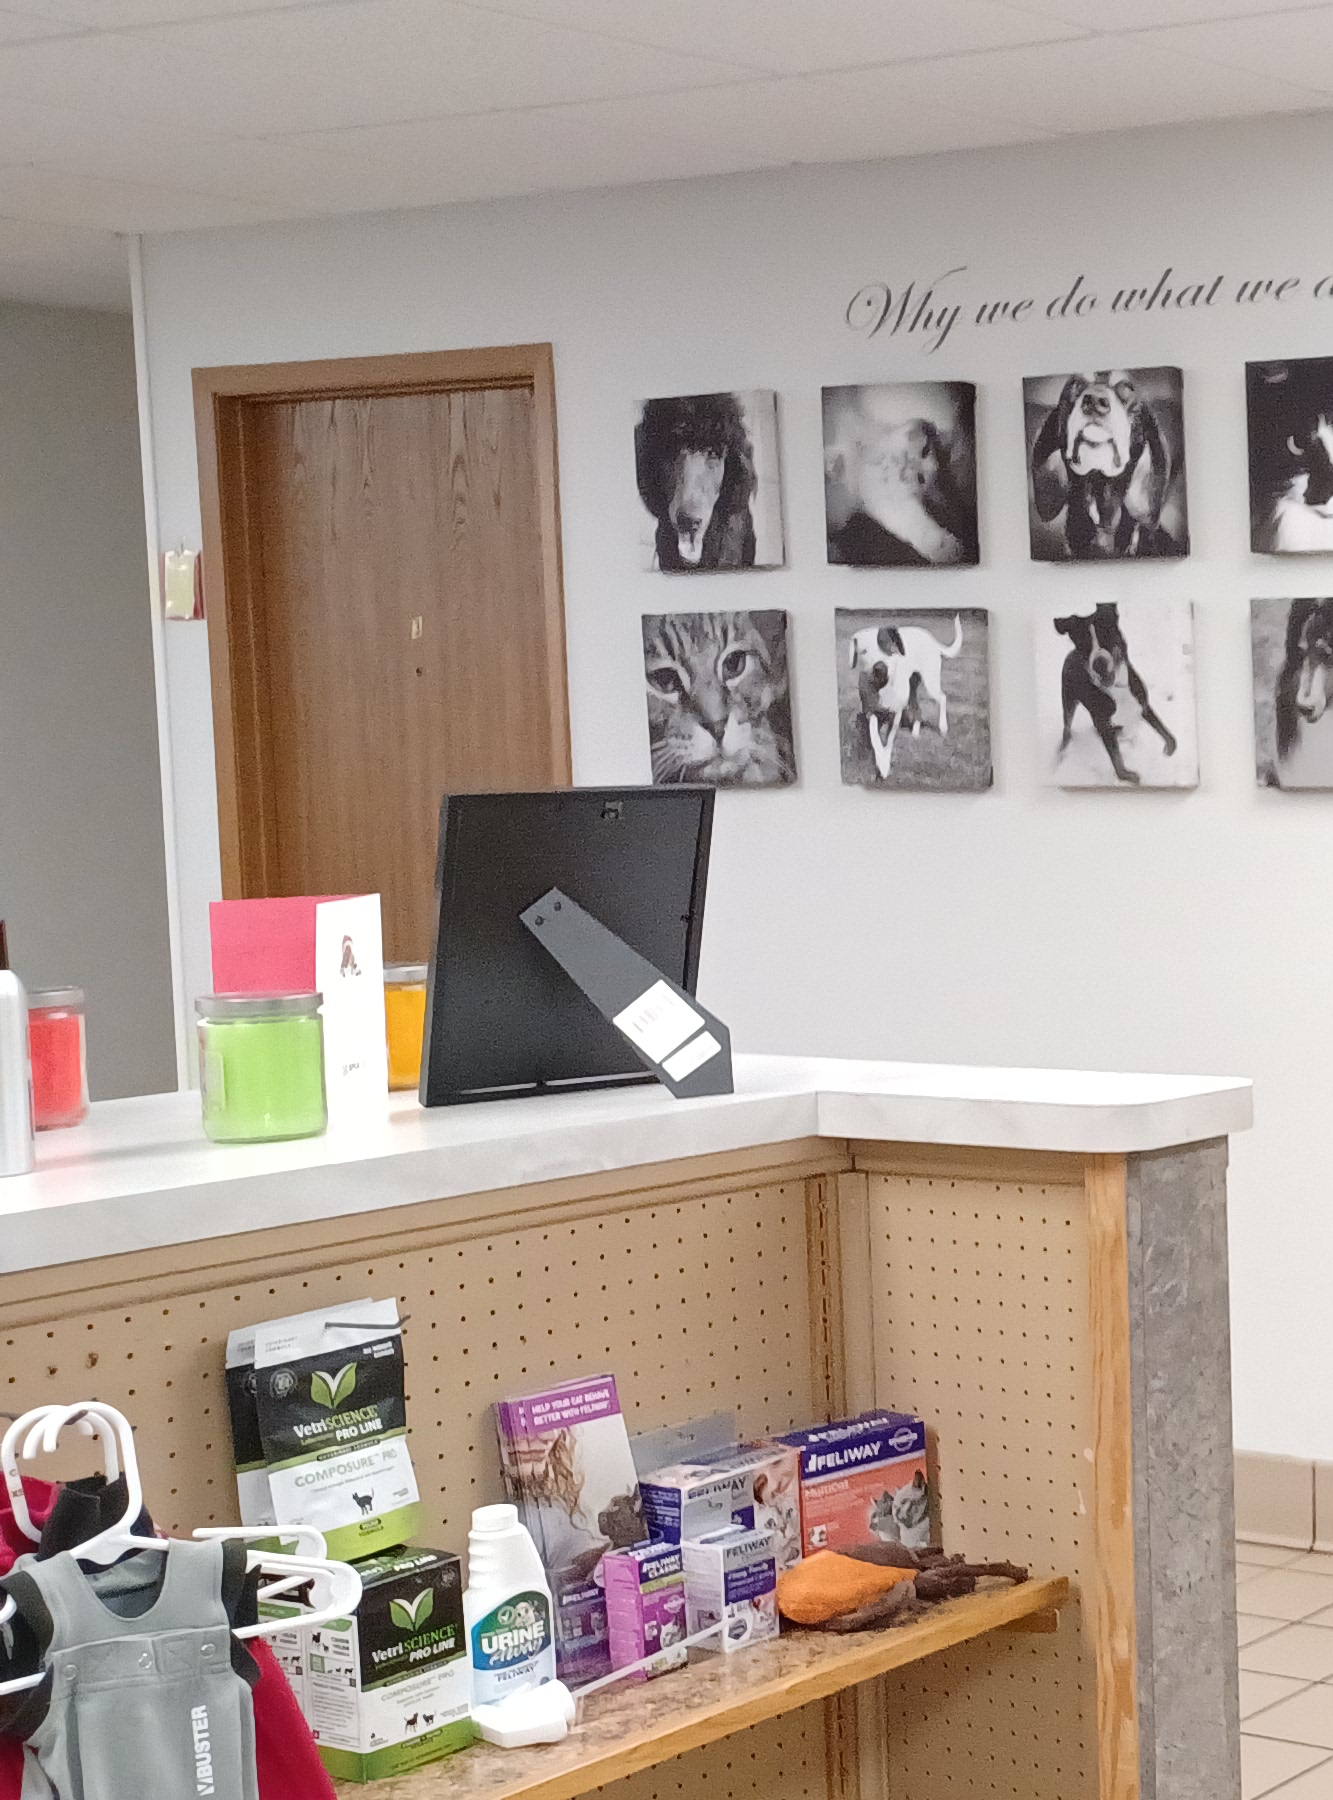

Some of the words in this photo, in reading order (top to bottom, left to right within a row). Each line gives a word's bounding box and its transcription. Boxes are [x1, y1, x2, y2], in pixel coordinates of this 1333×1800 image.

[846, 266, 968, 355] Why
[974, 300, 1034, 324] we
[1045, 274, 1098, 317] do
[1111, 267, 1224, 313] what
[1235, 277, 1300, 303] we
[335, 1425, 360, 1442] PRO
[359, 1418, 383, 1435] LINE
[409, 1646, 432, 1663] PRO
[432, 1637, 457, 1655] LINE
[481, 1620, 546, 1655] URINE
